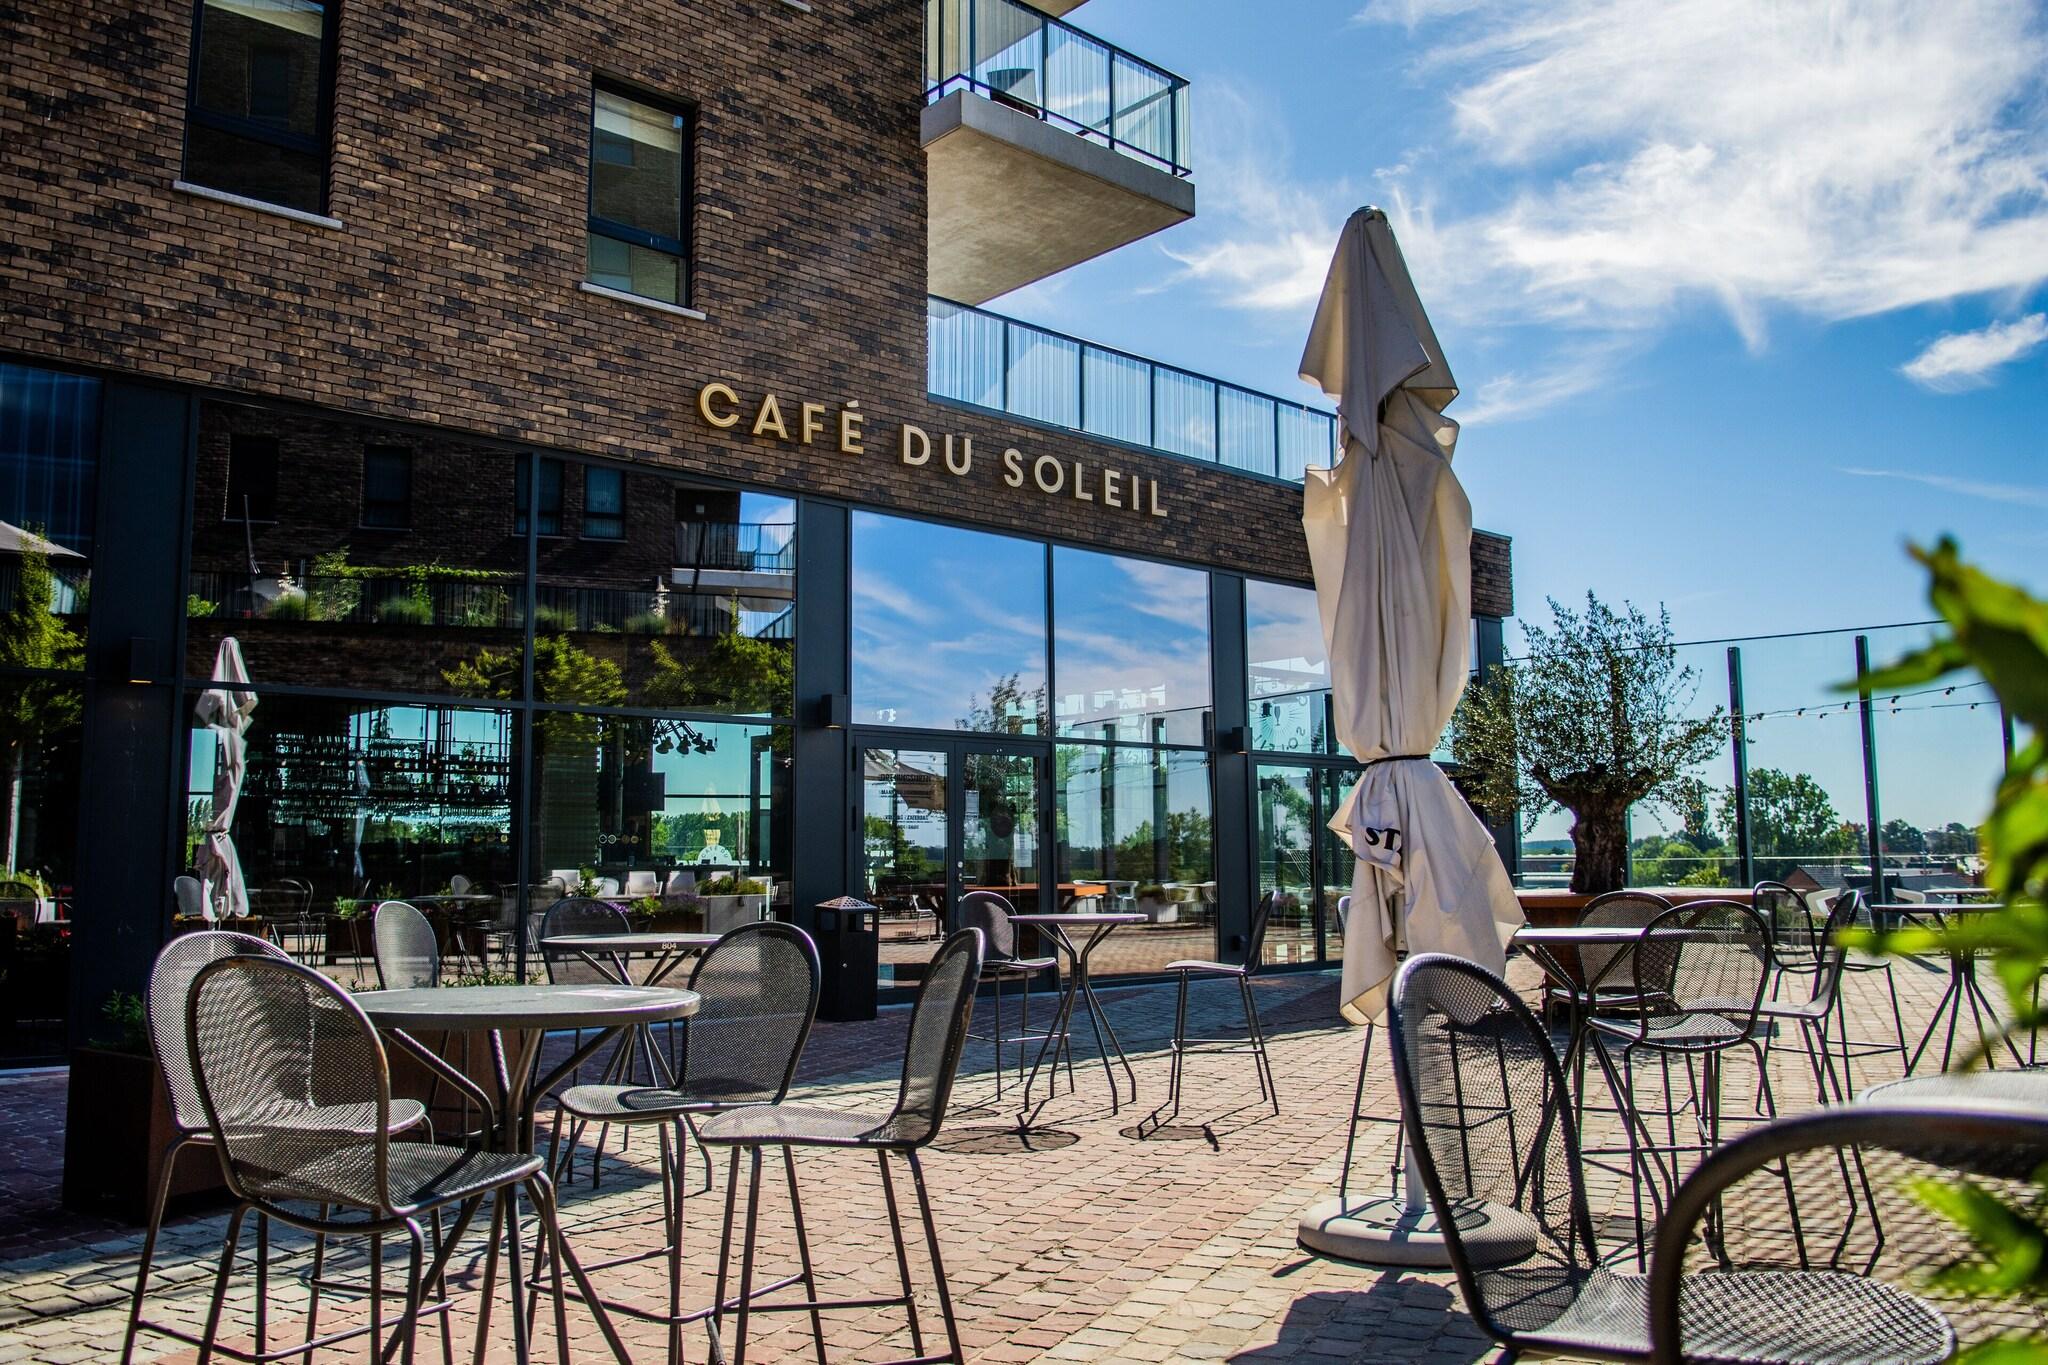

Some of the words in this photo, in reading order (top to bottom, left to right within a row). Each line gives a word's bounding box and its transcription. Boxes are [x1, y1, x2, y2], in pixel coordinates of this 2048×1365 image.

[697, 381, 865, 455] CAFÉ
[900, 423, 973, 477] DU
[1003, 447, 1169, 517] SOLEIL
[1365, 826, 1402, 854] ST
[661, 942, 677, 950] 804
